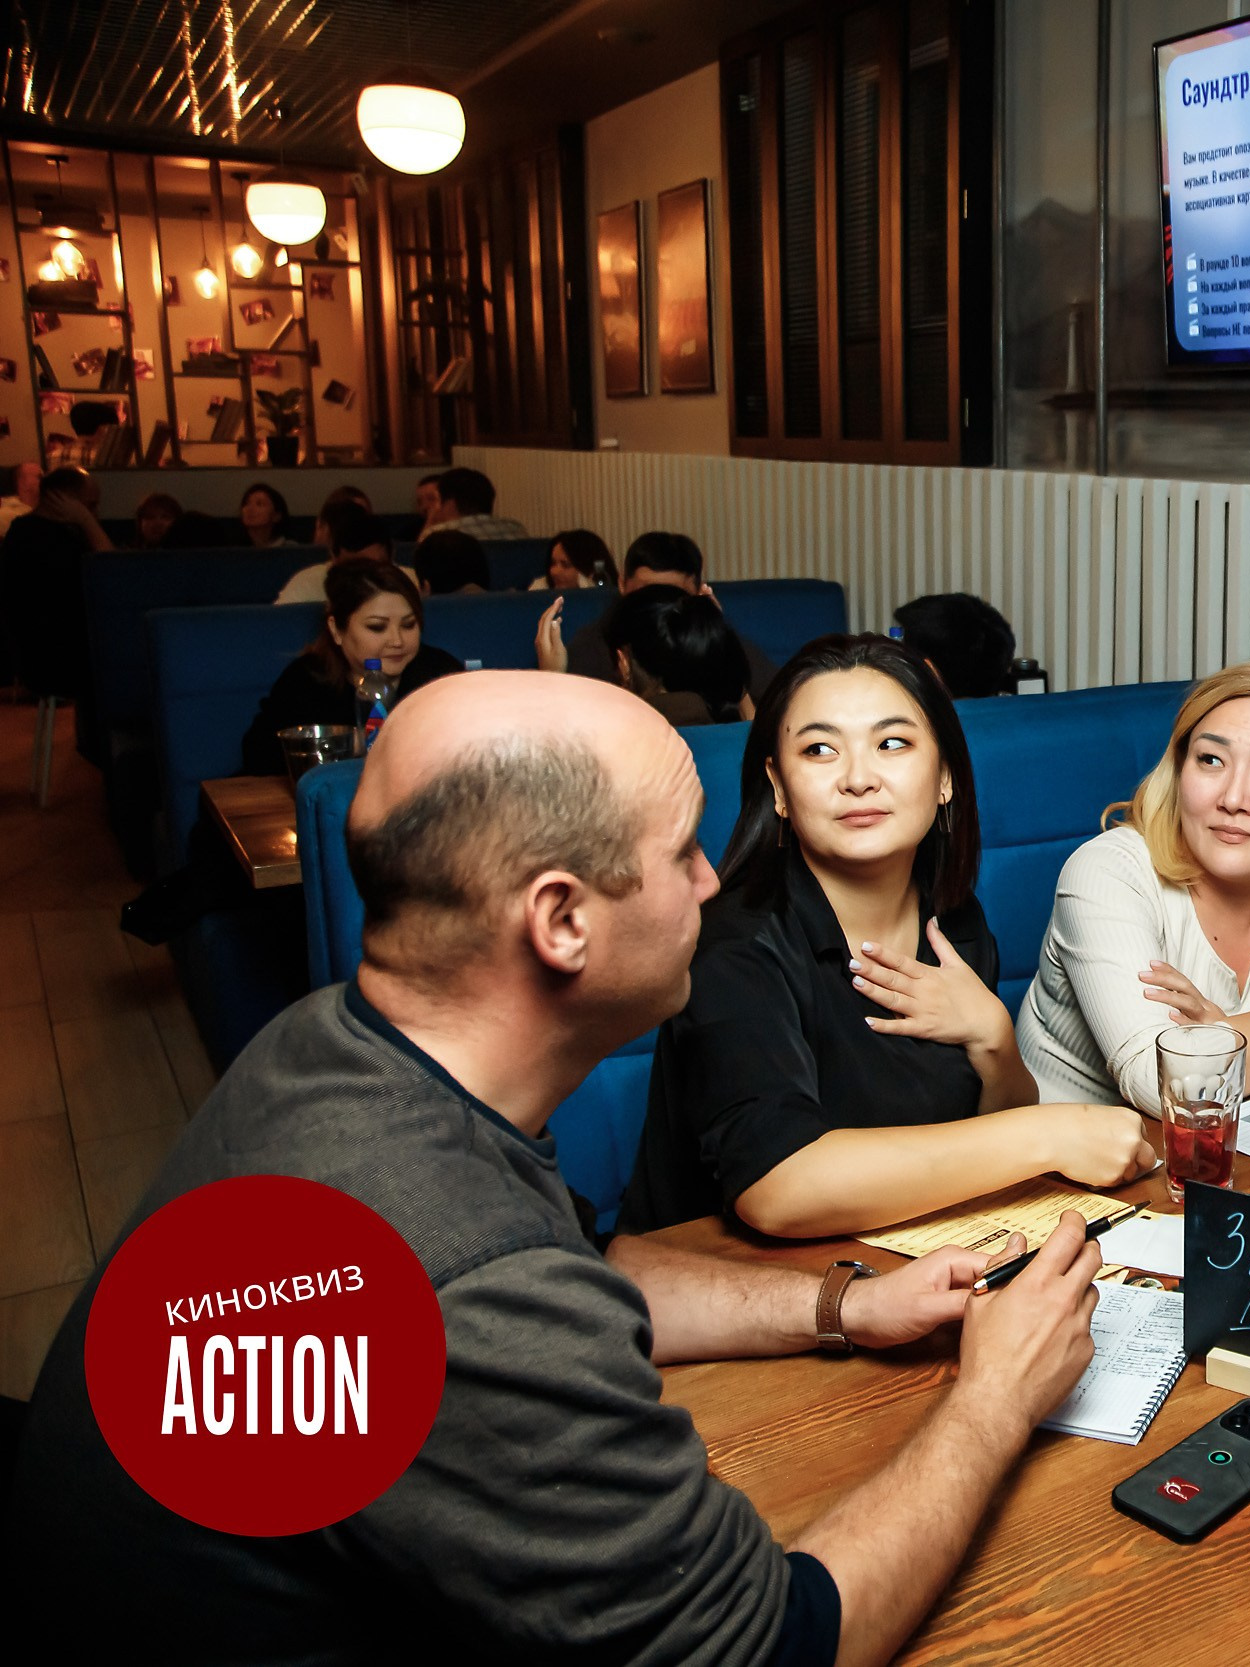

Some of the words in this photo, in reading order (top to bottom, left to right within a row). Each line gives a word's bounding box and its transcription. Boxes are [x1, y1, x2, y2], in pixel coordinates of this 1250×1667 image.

[1183, 151, 1197, 165] Вам
[1199, 146, 1233, 164] предстоит
[1212, 170, 1218, 184] В
[1219, 167, 1250, 182] качестве
[1185, 195, 1236, 212] ассоциативная
[1206, 259, 1230, 273] раунде
[1231, 254, 1240, 268] 10
[1232, 322, 1241, 336] НЕ
